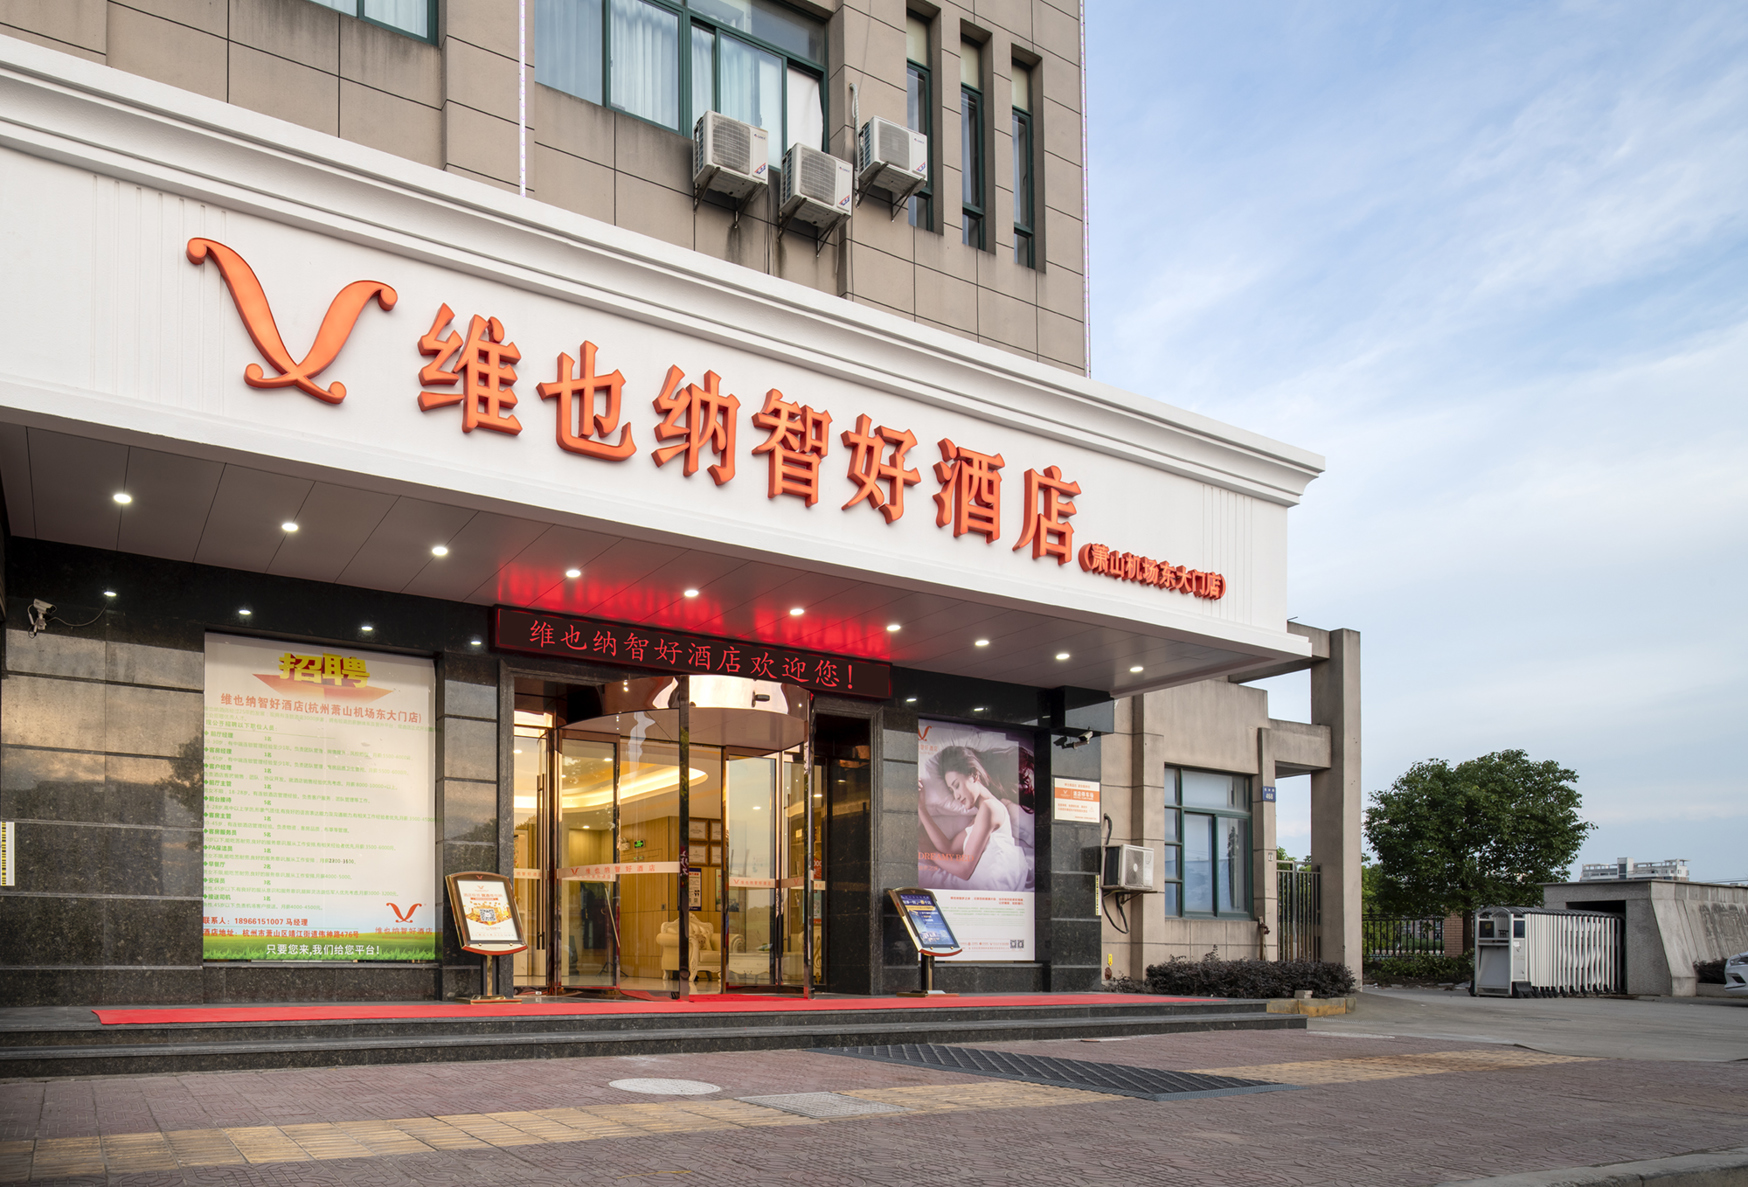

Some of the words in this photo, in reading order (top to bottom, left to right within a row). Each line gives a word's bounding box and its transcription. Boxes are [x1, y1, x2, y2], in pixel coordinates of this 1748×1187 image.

[417, 302, 1083, 567] 维也纳智好酒店
[278, 652, 370, 689] 招聘
[220, 692, 422, 724] 维也纳智好酒店(杭州萧山机场东大门店)
[918, 851, 955, 860] DREAMY
[286, 918, 308, 926] 马经理
